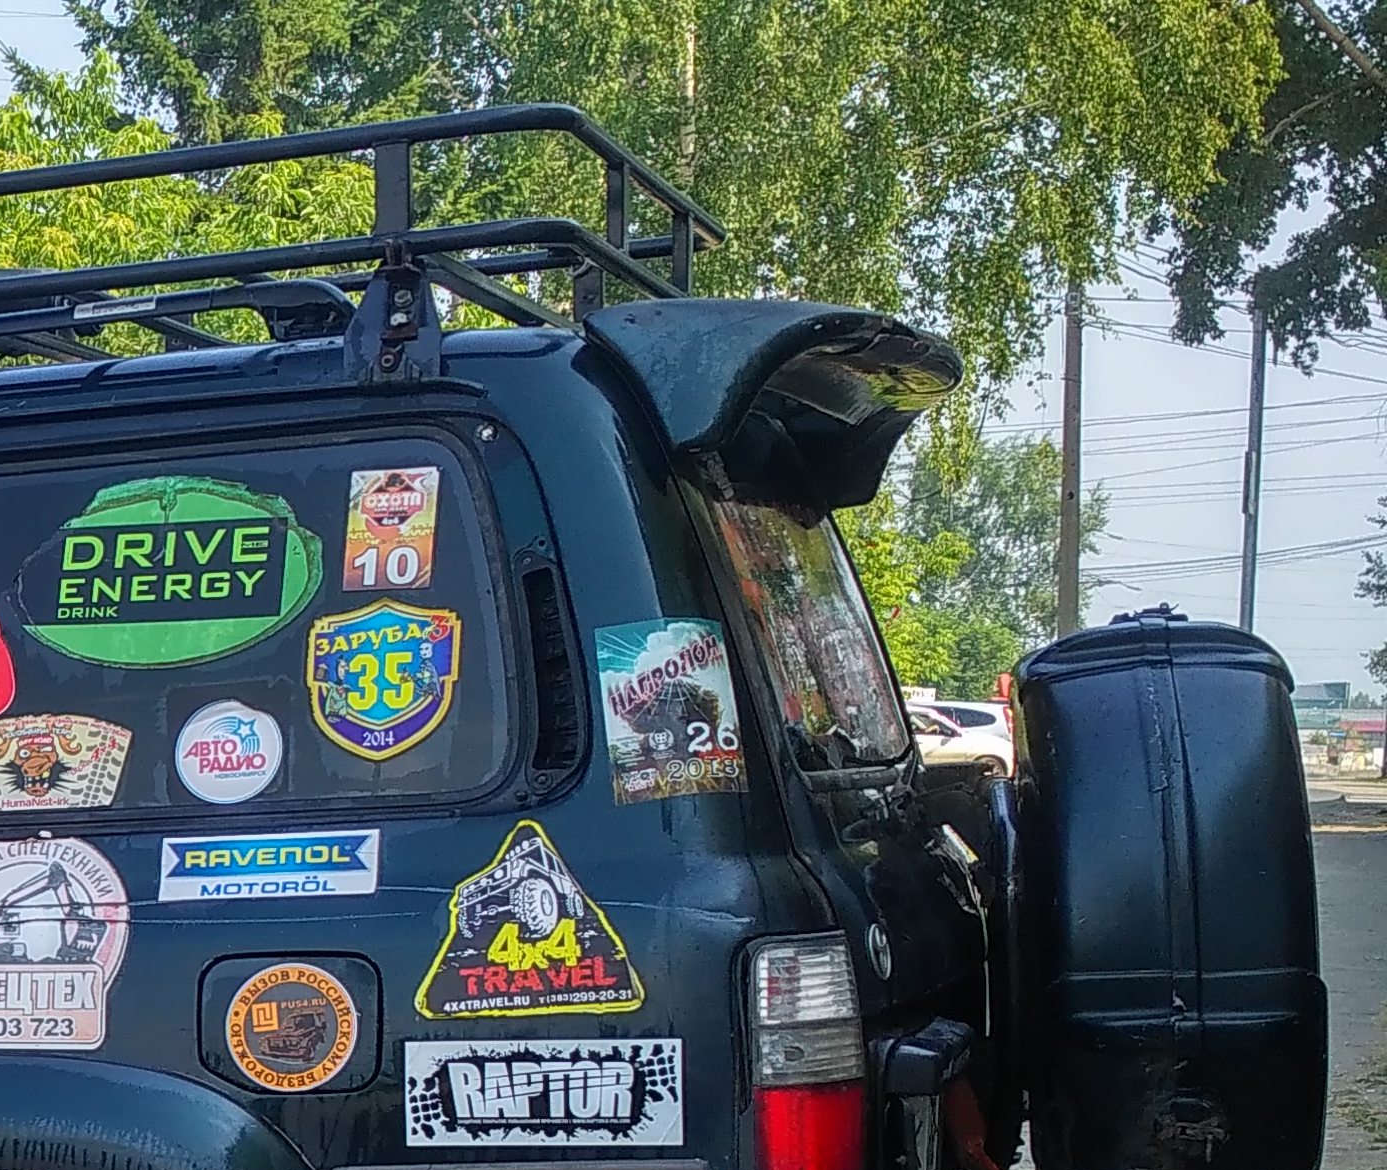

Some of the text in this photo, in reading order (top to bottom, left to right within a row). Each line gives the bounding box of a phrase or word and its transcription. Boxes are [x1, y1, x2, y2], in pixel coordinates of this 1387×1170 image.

[62, 526, 270, 571] DRIVE
[353, 546, 420, 587] 10
[58, 570, 266, 604] ENERGY
[57, 606, 119, 619] DRINK
[315, 622, 423, 657] ЗАРУБА
[347, 651, 415, 711] 35
[183, 739, 238, 759] АВТО
[362, 730, 395, 746] 2014
[686, 721, 739, 752] 26
[199, 753, 267, 774] РАДИО
[7, 841, 115, 898] СПЕЦТЕХНИКИ
[185, 845, 351, 869] RAVENOL
[200, 876, 337, 897] MOTORÖL
[488, 918, 581, 970] 4x4
[459, 957, 618, 995] TRAVEL
[280, 997, 327, 1010] PU54.RU
[444, 995, 530, 1012] 4X4TRAVEL.RU
[30, 1018, 74, 1037] 723
[230, 970, 351, 1089] ВЫЗОВ РОССИЙСКОМУ БЕЗДОРОЖЬЮ
[448, 1061, 635, 1117] RAPTOR
